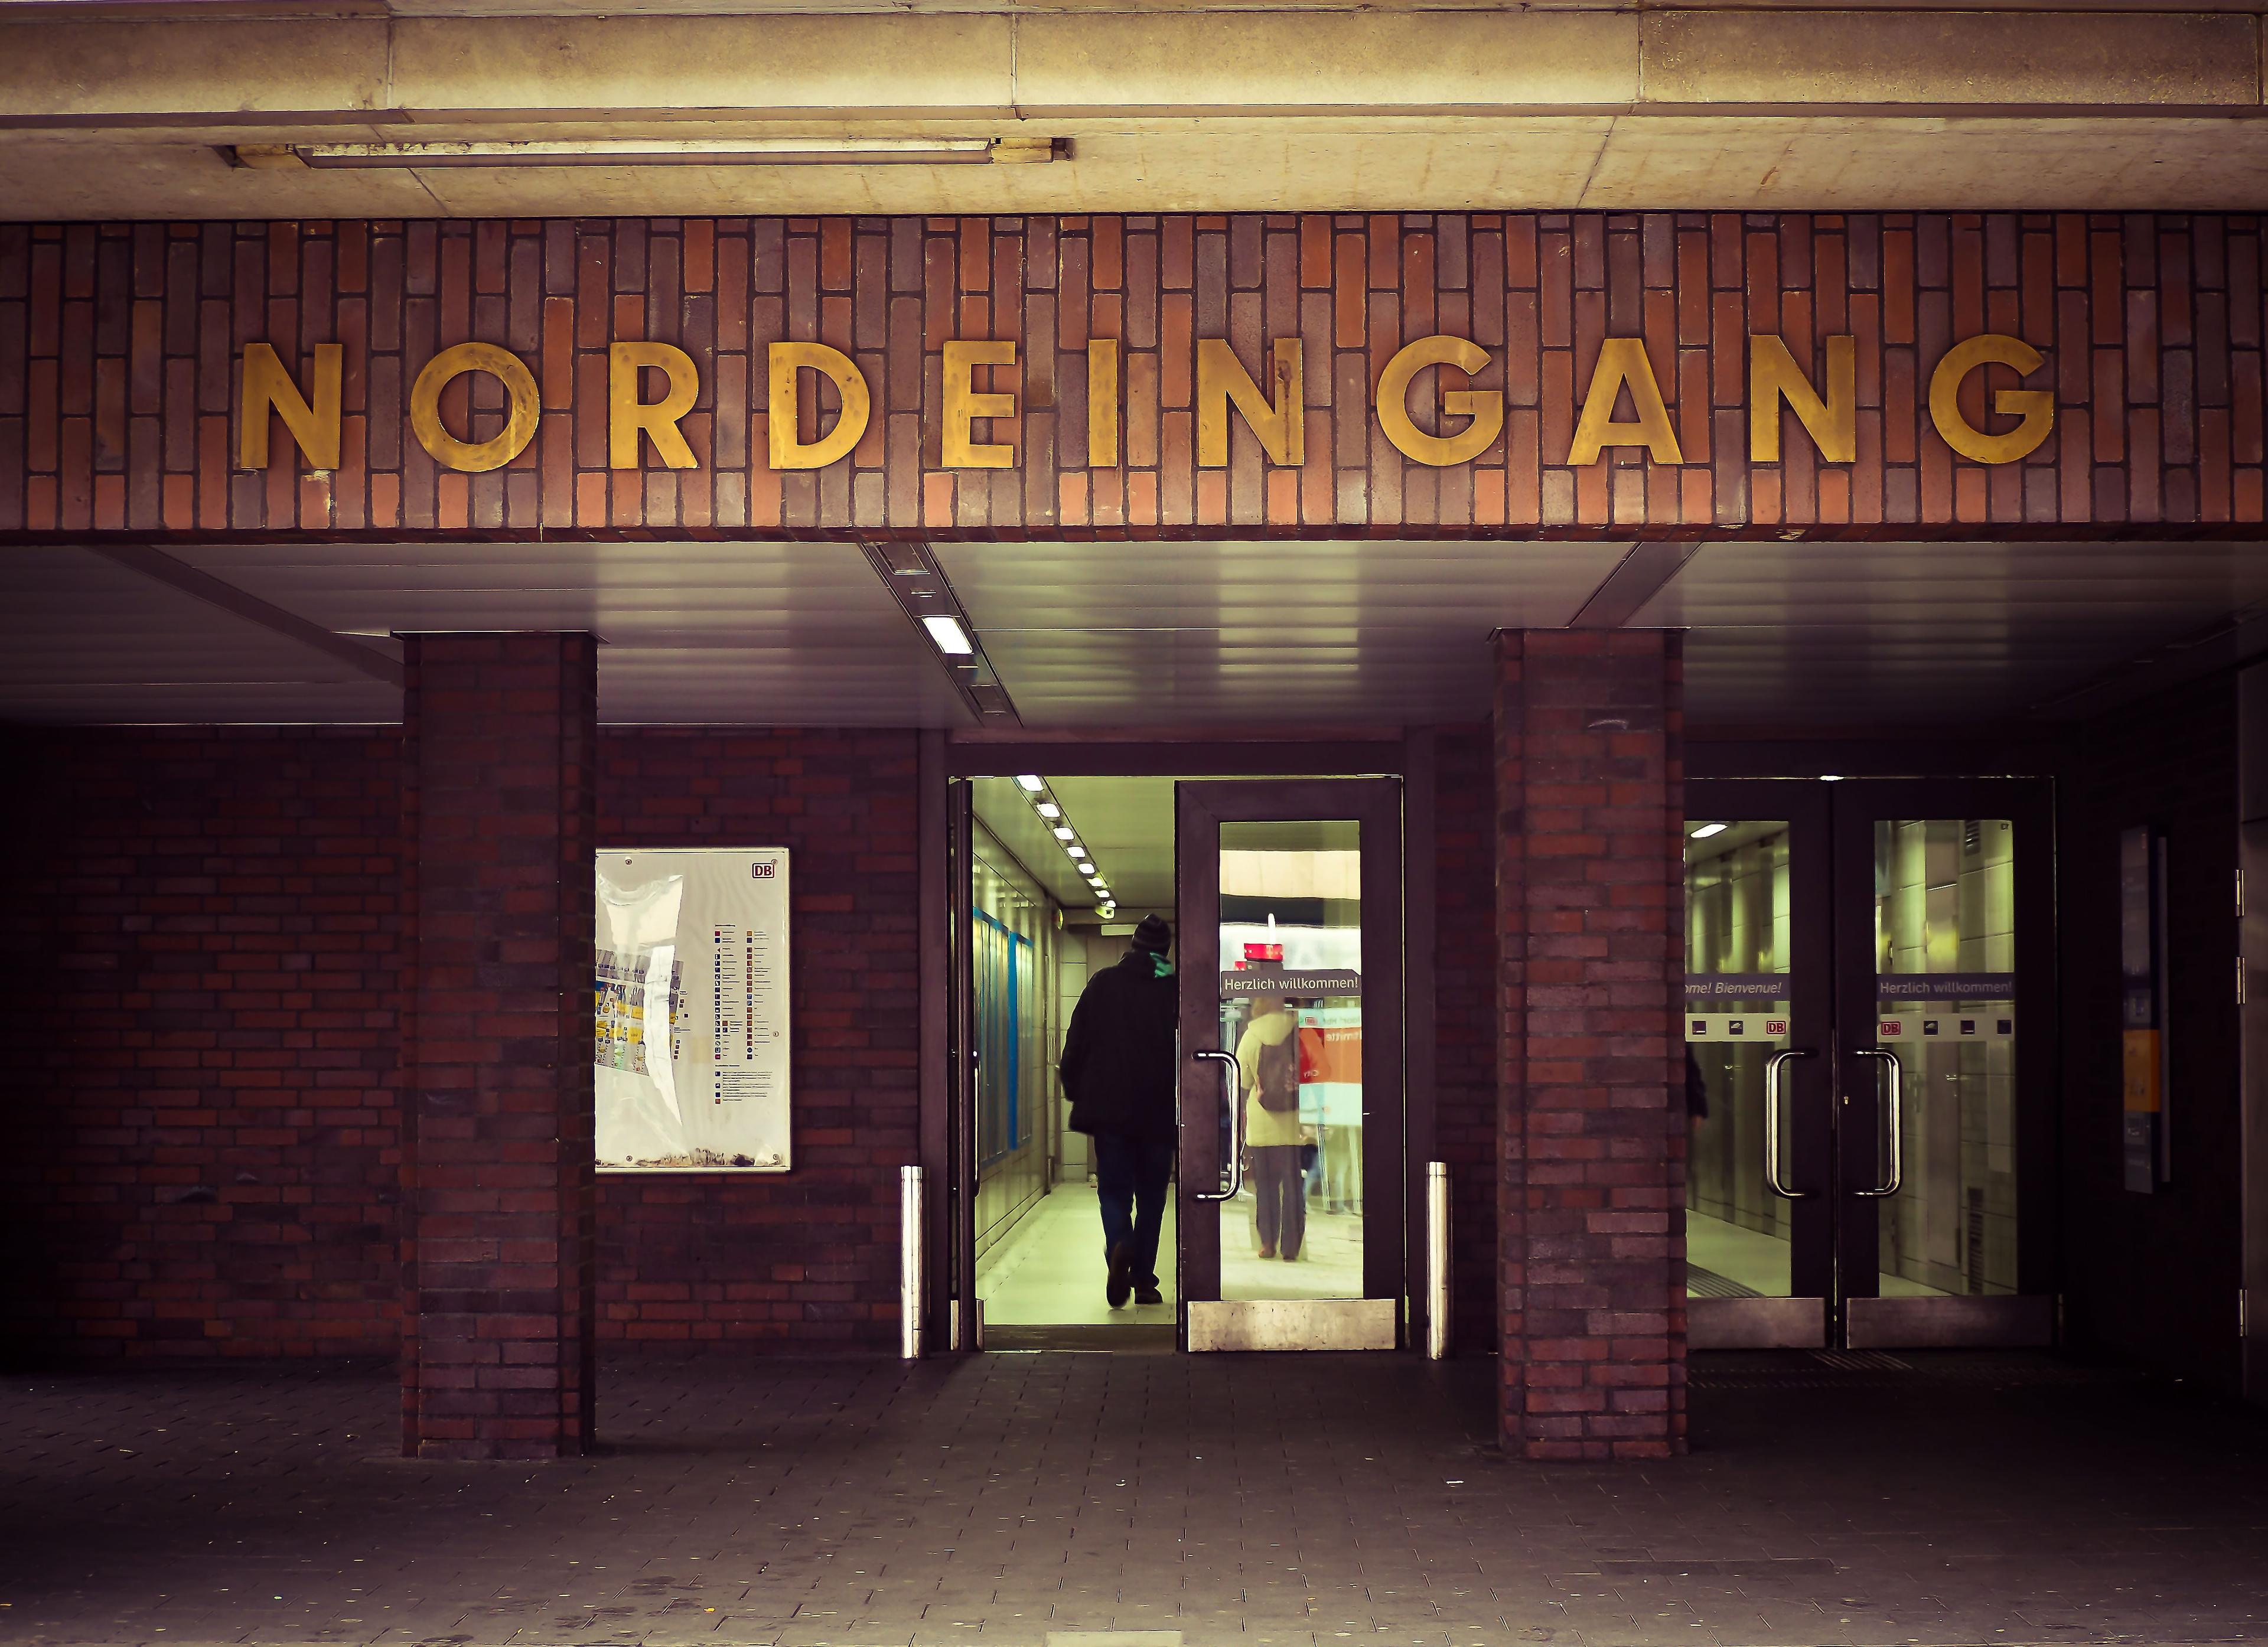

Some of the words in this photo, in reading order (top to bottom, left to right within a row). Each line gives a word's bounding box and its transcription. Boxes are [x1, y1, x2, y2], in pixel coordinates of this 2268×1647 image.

[240, 334, 2055, 471] NORDEINGANG
[755, 865, 772, 876] DB
[1225, 979, 1275, 990] Herzlich
[1279, 977, 1358, 989] willkommen!
[1715, 982, 1782, 993] Bienvenue!
[1881, 983, 1930, 993] Herzlich
[1934, 981, 2012, 993] willkommen!
[1768, 1023, 1784, 1032] DB
[1883, 1023, 1898, 1033] DB
